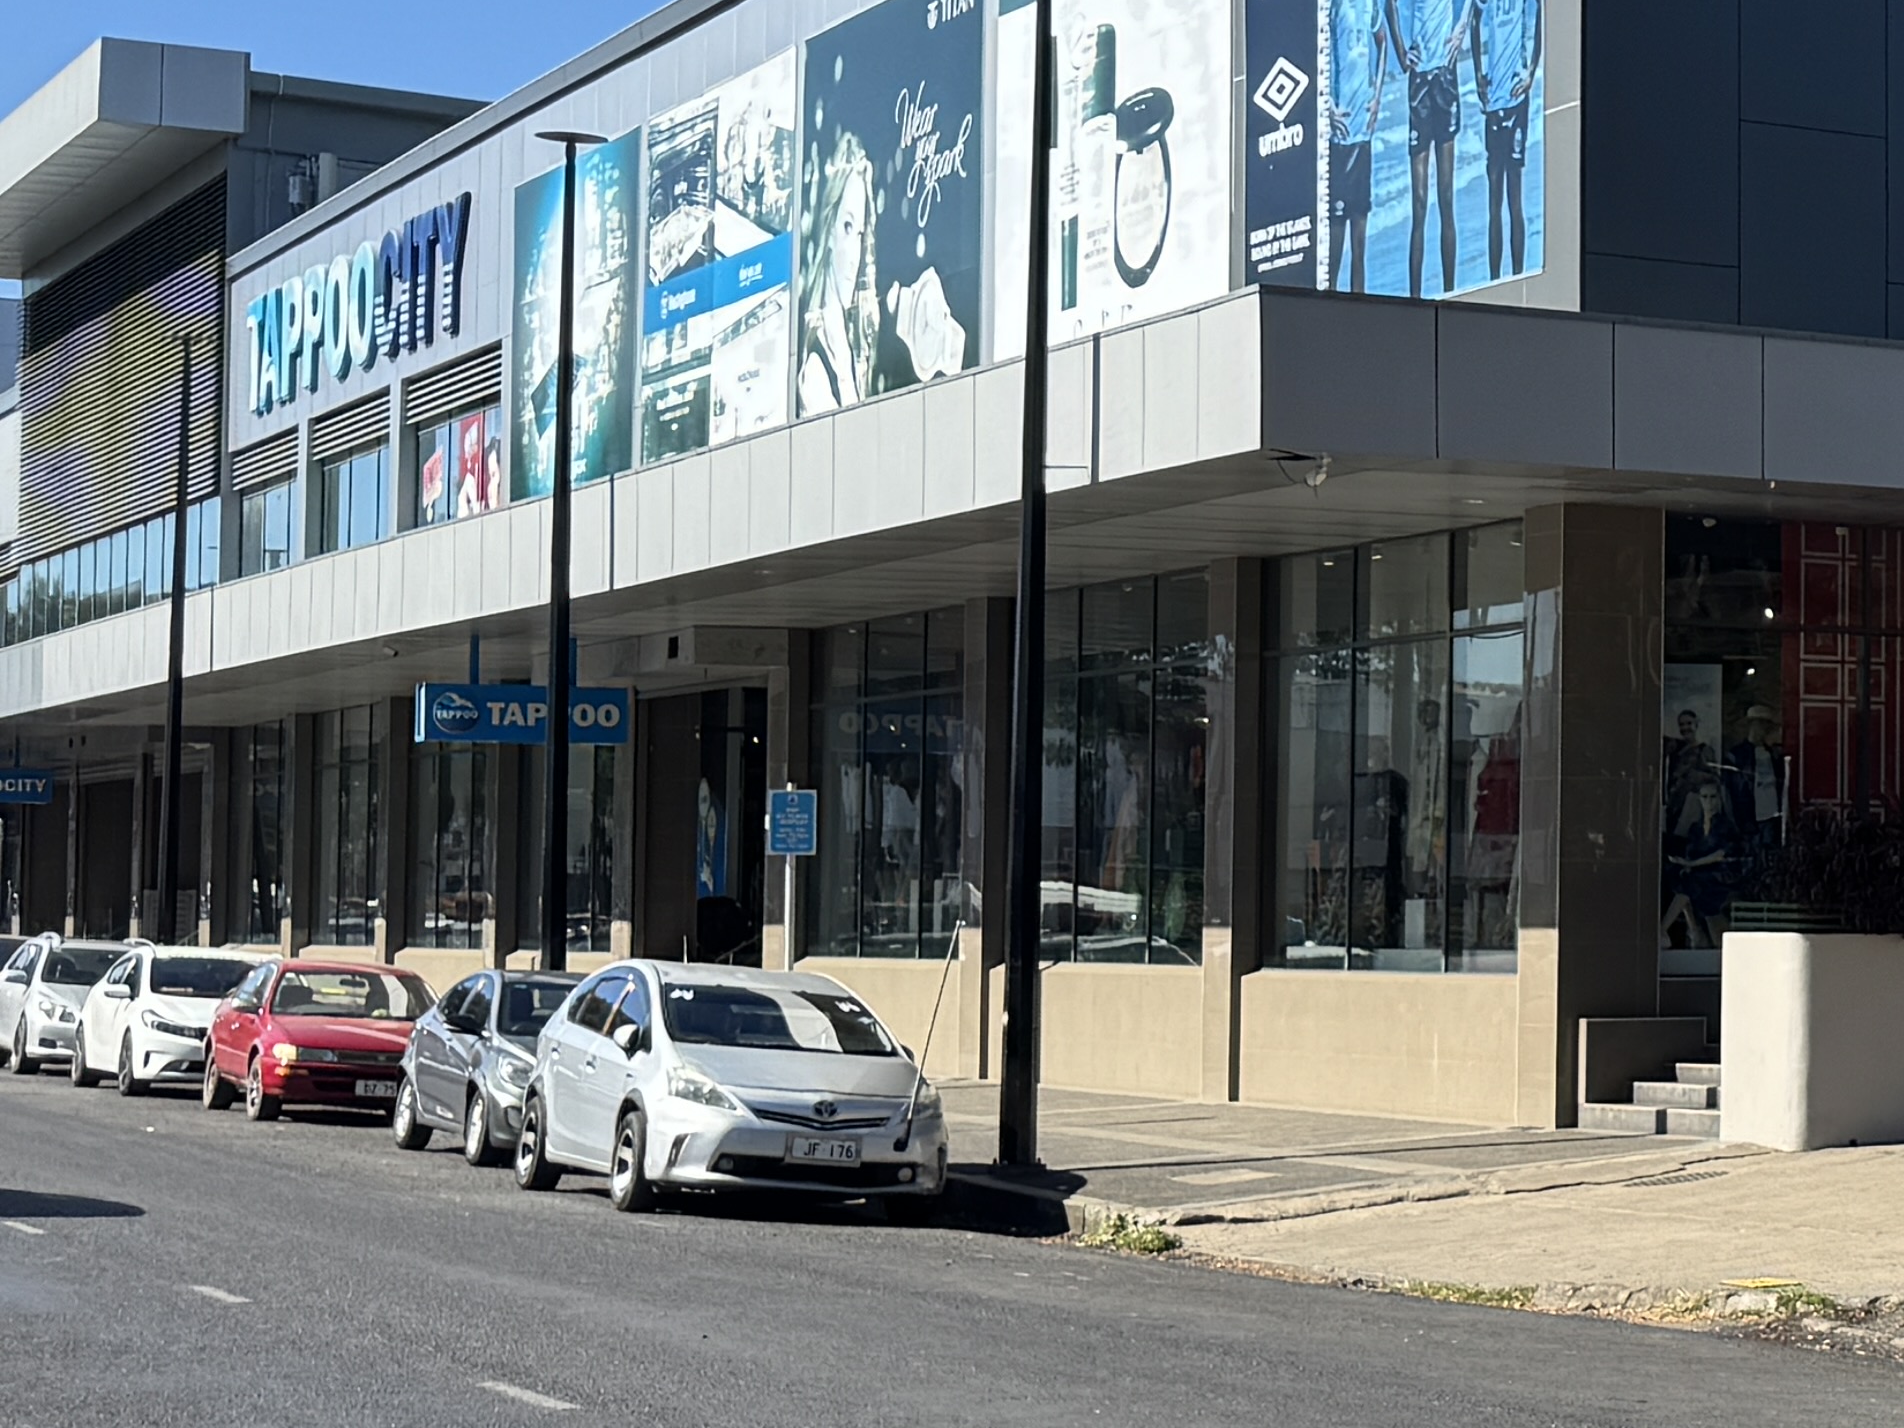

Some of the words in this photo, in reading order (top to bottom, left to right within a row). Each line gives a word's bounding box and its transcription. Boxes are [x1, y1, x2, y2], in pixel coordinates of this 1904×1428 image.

[1258, 123, 1304, 157] umbro
[486, 701, 620, 727] TAPOO
[0, 778, 46, 793] CITY
[803, 1142, 820, 1156] JF
[830, 1144, 853, 1159] 176
